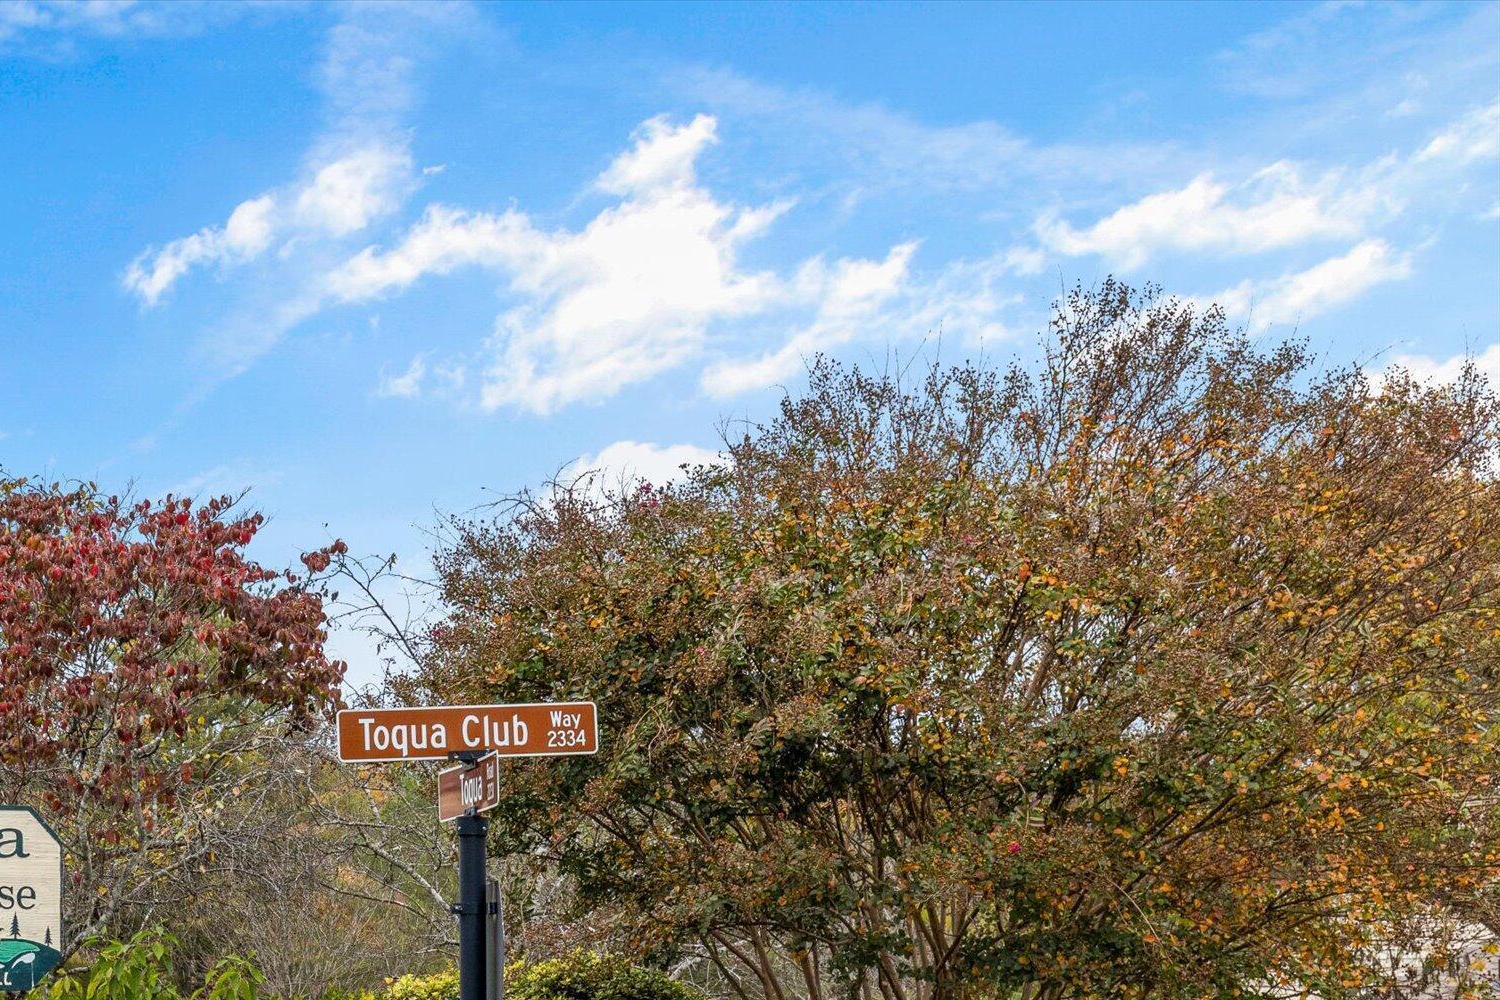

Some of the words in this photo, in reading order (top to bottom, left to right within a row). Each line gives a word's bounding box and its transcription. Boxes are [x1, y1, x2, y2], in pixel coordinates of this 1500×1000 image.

[550, 710, 581, 729] Way
[358, 718, 447, 757] Toqua
[462, 714, 529, 748] Club
[547, 729, 587, 748] 2334
[459, 773, 483, 806] Toqua
